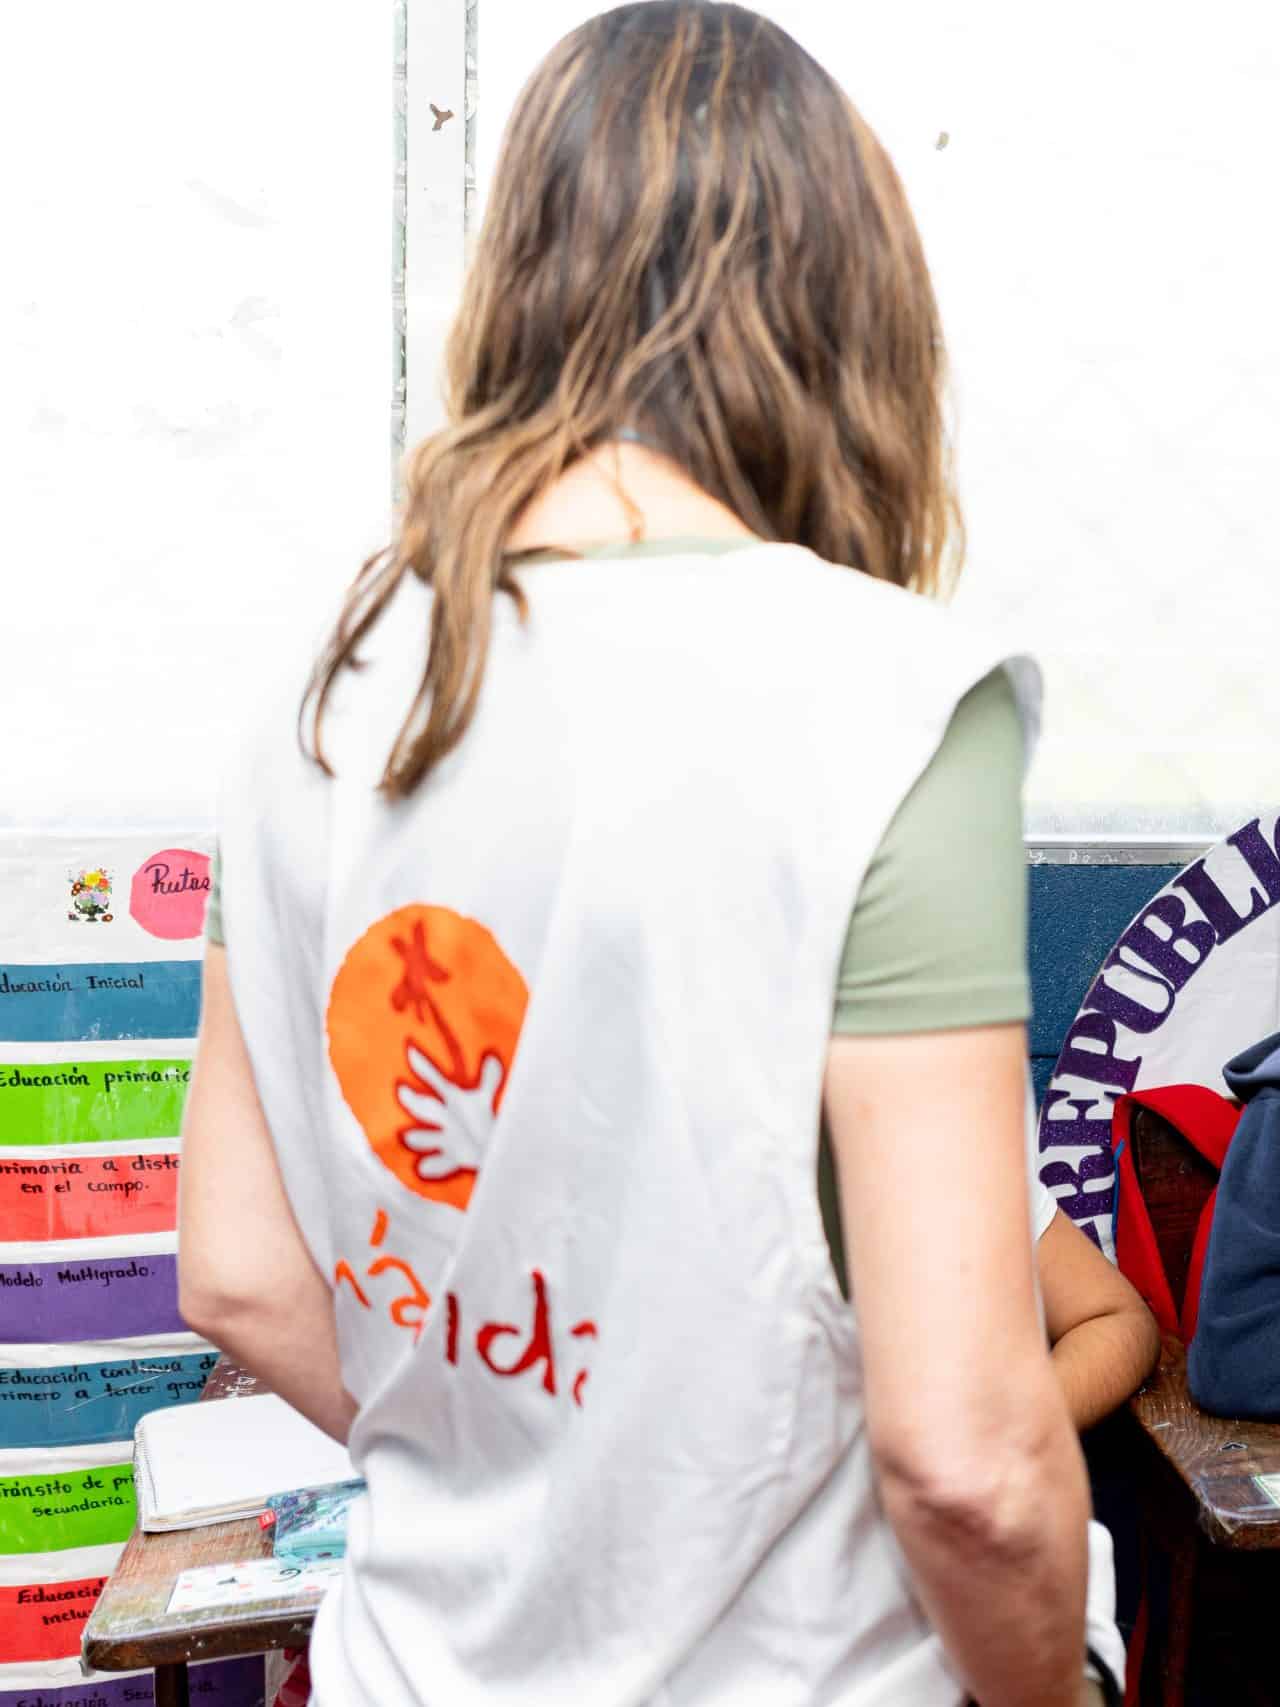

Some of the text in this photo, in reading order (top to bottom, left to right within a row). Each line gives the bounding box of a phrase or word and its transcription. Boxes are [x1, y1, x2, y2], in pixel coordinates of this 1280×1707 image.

[0, 973, 145, 994] ducación Inicial
[0, 1162, 83, 1175] rimaria
[102, 1159, 119, 1172] a
[20, 1182, 44, 1194] en
[54, 1180, 72, 1193] el
[0, 1389, 62, 1401] rimero
[74, 1388, 90, 1400] a
[166, 1374, 208, 1399] grad
[81, 1474, 105, 1491] de
[31, 1498, 131, 1518] secundaria.
